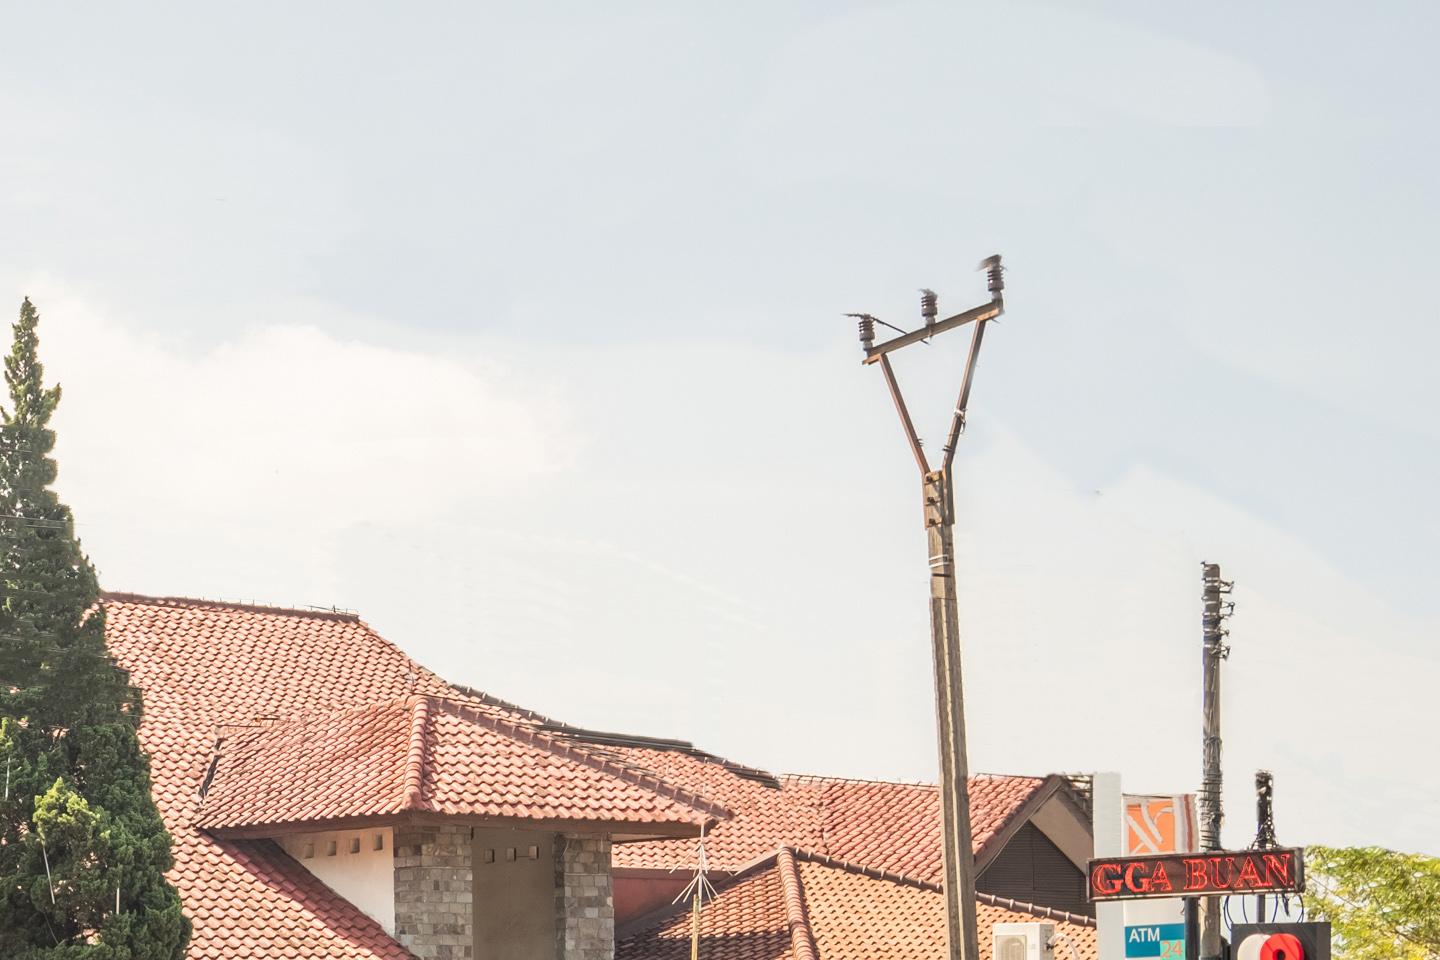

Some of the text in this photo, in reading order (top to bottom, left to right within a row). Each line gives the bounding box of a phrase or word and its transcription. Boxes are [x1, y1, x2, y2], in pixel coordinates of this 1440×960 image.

[1183, 853, 1295, 891] BUAN
[1128, 927, 1160, 943] ATM
[1160, 940, 1183, 958] 24
